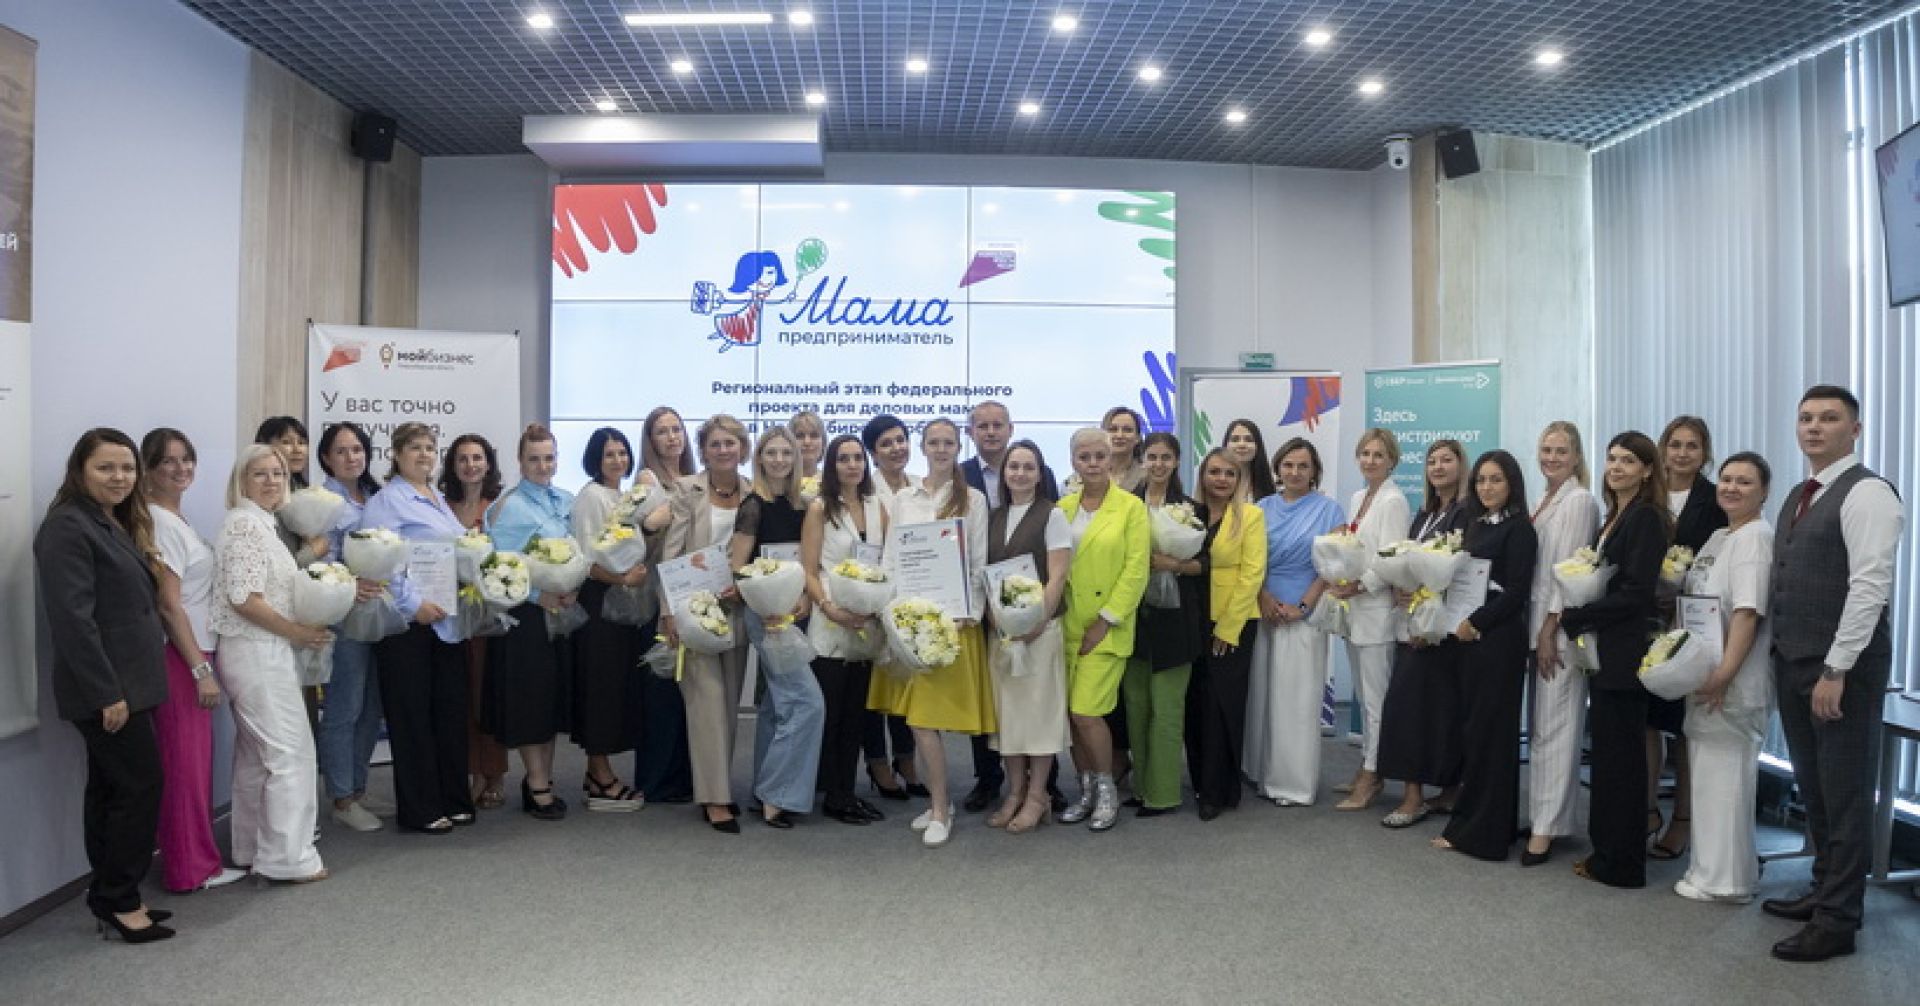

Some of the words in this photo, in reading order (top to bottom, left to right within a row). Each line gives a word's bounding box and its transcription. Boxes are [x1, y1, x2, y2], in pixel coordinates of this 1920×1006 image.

[779, 275, 954, 326] Мама
[778, 331, 954, 346] предприниматель
[711, 380, 839, 394] Региональный
[844, 384, 881, 395] этап
[886, 381, 1013, 398] федерального
[321, 390, 339, 412] У
[346, 398, 383, 413] вас
[390, 399, 456, 415] точно
[748, 402, 820, 415] проекта
[823, 403, 856, 414] для
[859, 404, 935, 415] деловых
[1373, 406, 1417, 424] Здесь
